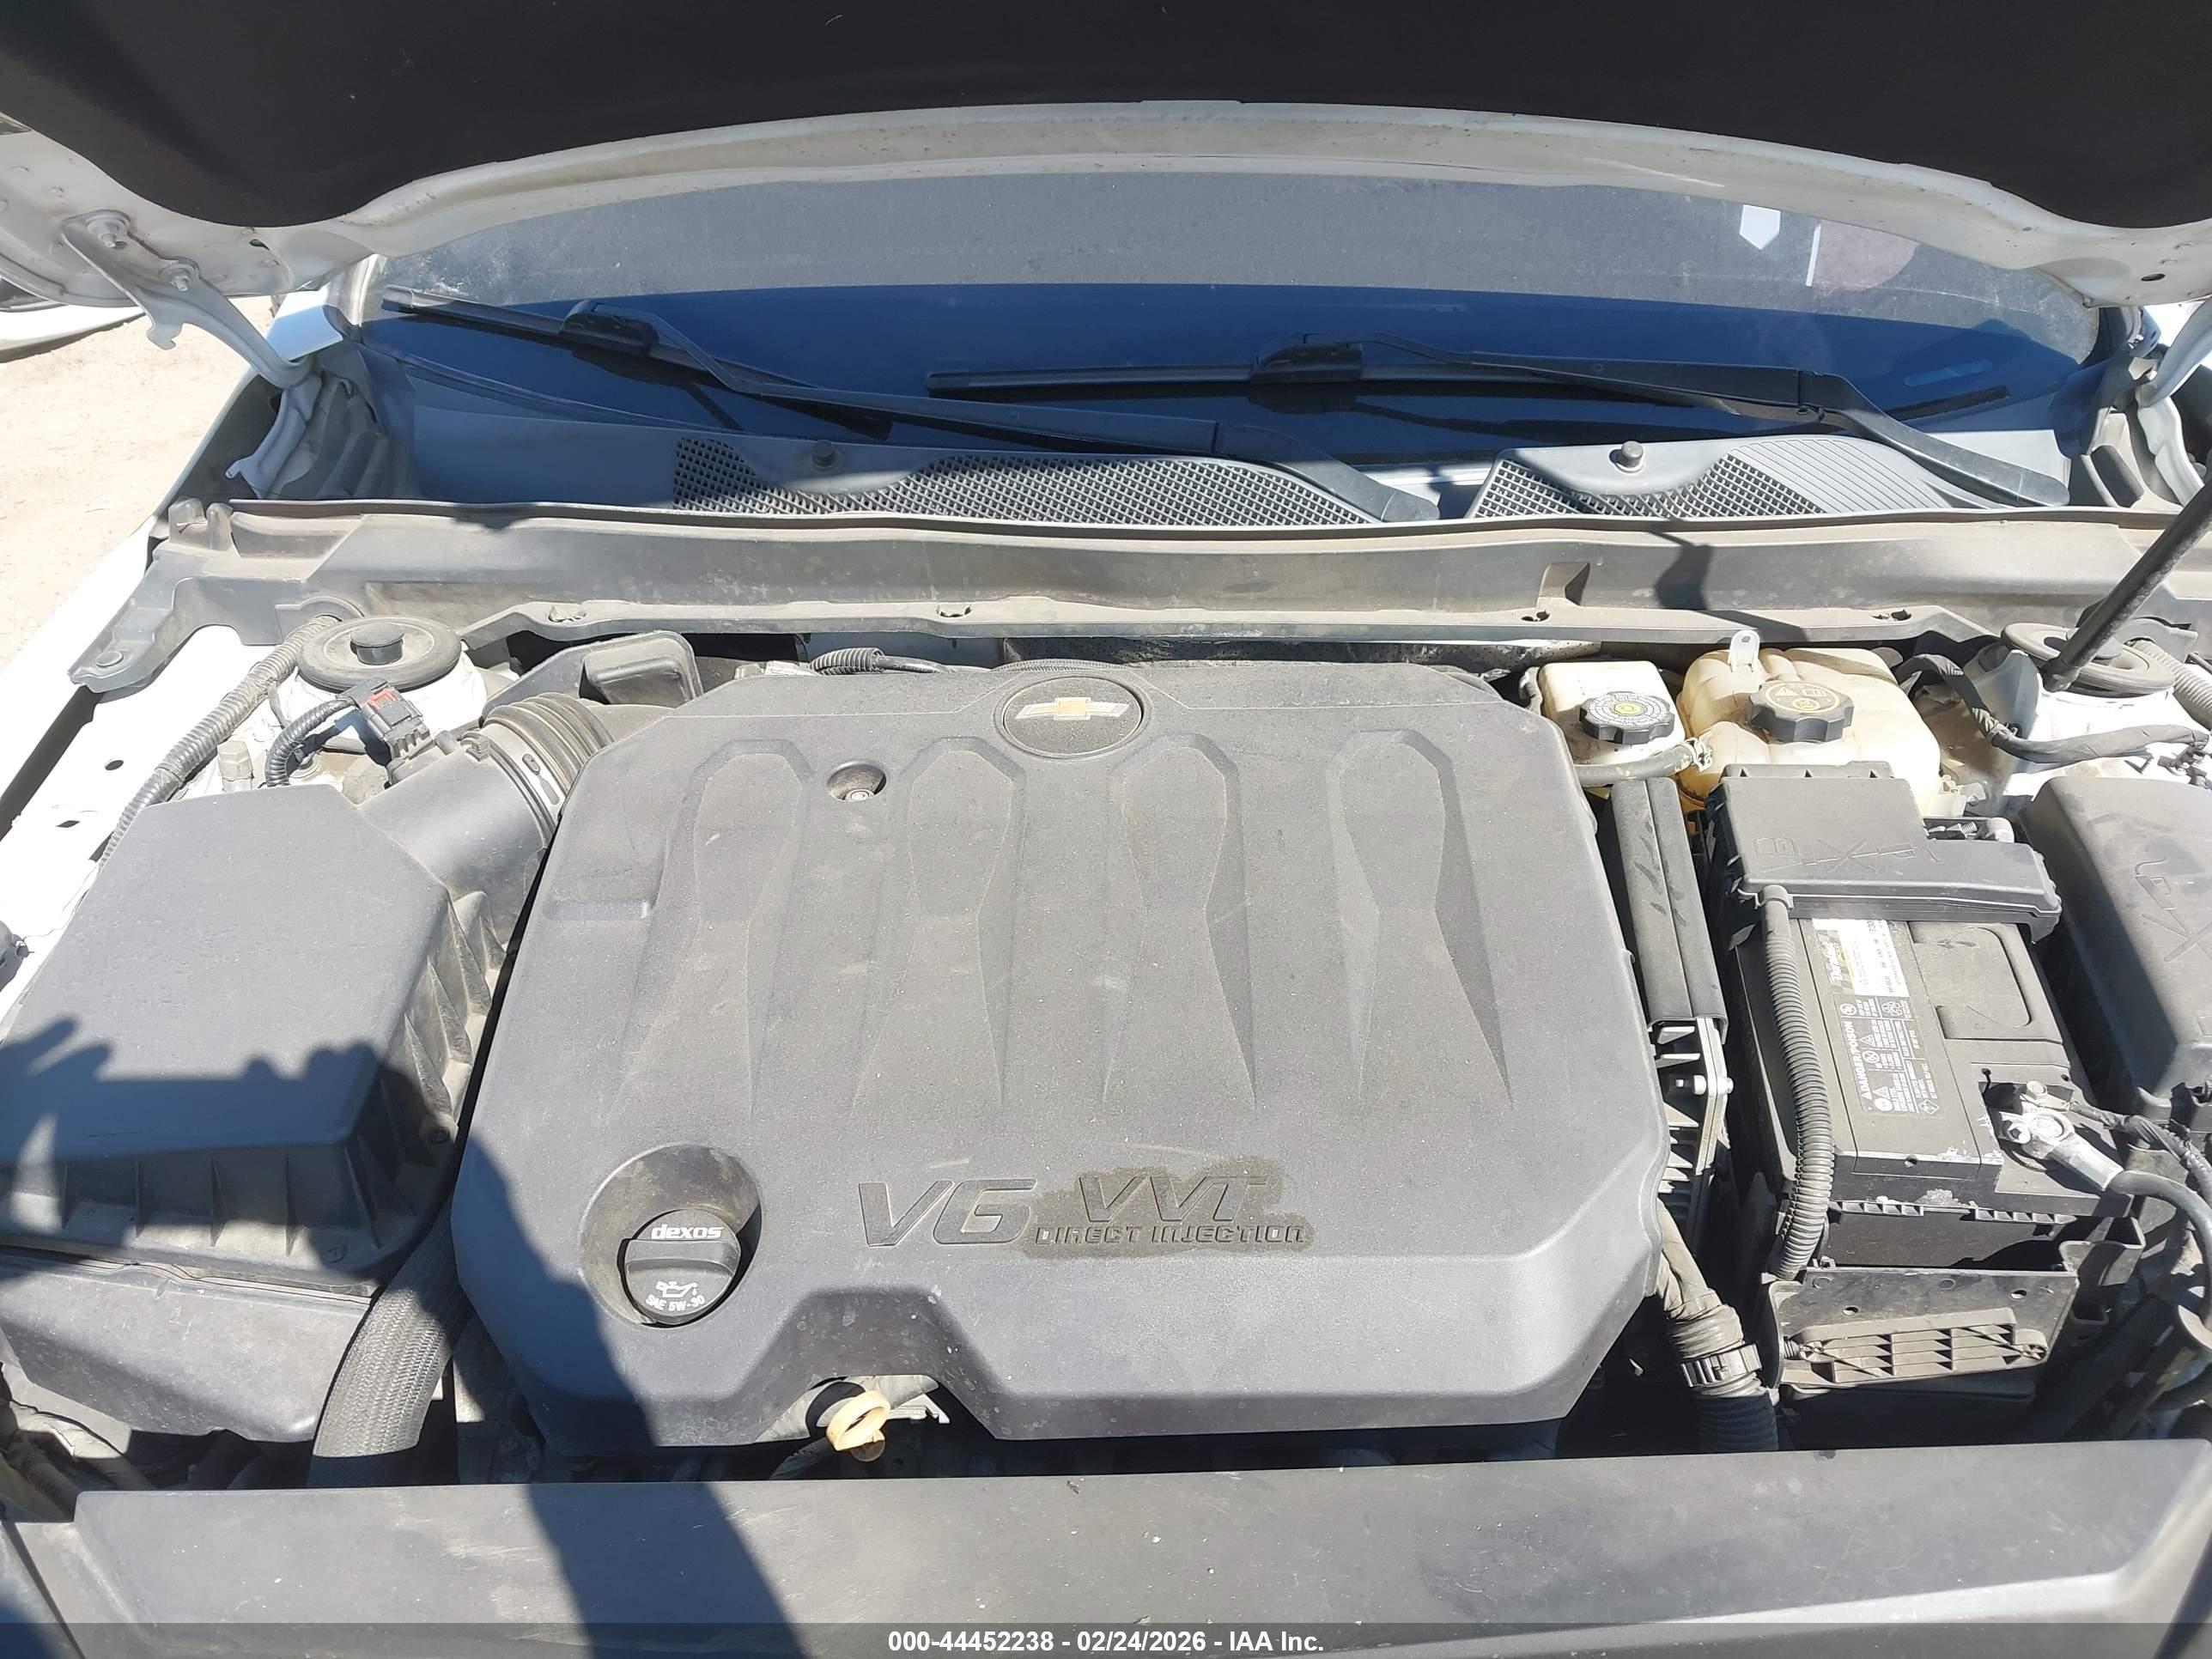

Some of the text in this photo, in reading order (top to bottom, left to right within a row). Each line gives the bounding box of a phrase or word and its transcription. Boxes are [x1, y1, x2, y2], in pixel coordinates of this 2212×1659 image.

[1844, 1020, 1870, 1092] DANGER/POISON
[857, 1177, 1037, 1247] V6
[1078, 1175, 1269, 1223] VVT
[651, 1224, 725, 1240] dexos
[1034, 1224, 1305, 1246] DIRECT INJECTION
[645, 1294, 706, 1312] SAE 5W-30
